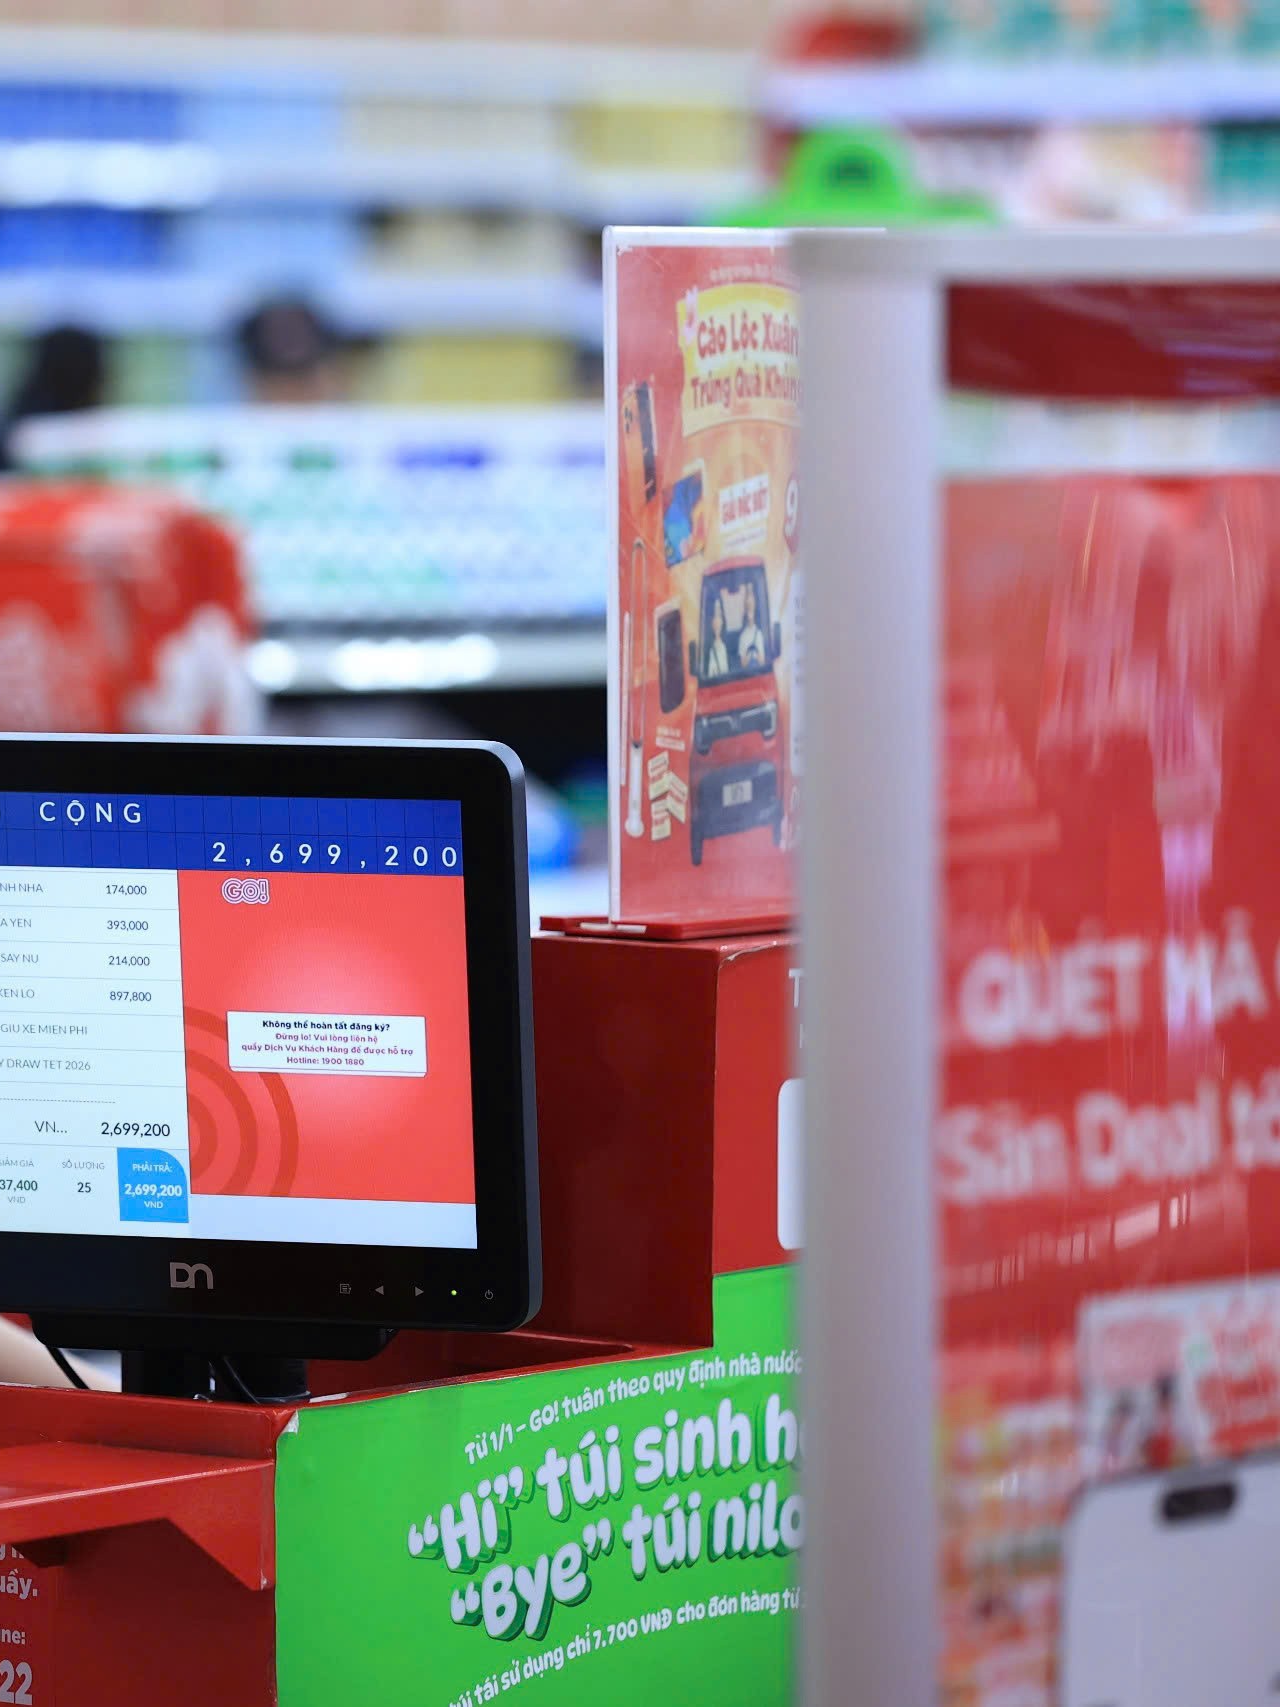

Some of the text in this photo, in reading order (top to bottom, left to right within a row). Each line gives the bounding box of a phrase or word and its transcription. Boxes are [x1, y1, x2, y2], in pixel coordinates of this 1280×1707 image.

[39, 800, 142, 825] CỘNG
[212, 842, 457, 868] 2,699,200
[18, 883, 44, 893] NHA
[105, 884, 147, 897] 174,000
[222, 878, 270, 905] GO!
[10, 918, 32, 928] YEN
[107, 920, 149, 933] 393,000
[1, 953, 20, 963] SAY
[22, 954, 39, 963] NU
[108, 955, 150, 968] 214,000
[21, 988, 35, 999] LO
[109, 991, 152, 1004] 897,800
[0, 1023, 20, 1033] GIU
[22, 1024, 36, 1034] XE
[38, 1024, 67, 1035] MIEN
[69, 1025, 88, 1035] PHI
[262, 1020, 292, 1031] Không
[6, 1058, 40, 1069] DRAW
[43, 1060, 62, 1070] TET
[65, 1061, 91, 1071] 2026
[286, 1056, 320, 1065] Hotline:
[322, 1057, 342, 1065] 1900
[101, 1122, 171, 1138] 2,699,200
[77, 1182, 92, 1193] 25
[124, 1184, 183, 1198] 2,699,200
[144, 1201, 164, 1209] VND
[464, 1431, 489, 1465] Từ
[490, 1422, 514, 1453] 1/1
[529, 1400, 560, 1433] GO!
[562, 1386, 605, 1420] tuân
[607, 1376, 650, 1403] theo
[653, 1367, 686, 1395] quy
[688, 1356, 726, 1389] định
[728, 1351, 761, 1377] nhà
[535, 1424, 623, 1518] túi
[633, 1397, 752, 1485] sinh
[622, 1490, 702, 1575] túi
[474, 1673, 499, 1706] tái
[500, 1659, 521, 1691] sử
[523, 1645, 565, 1679] dụng
[566, 1624, 592, 1659] chỉ
[593, 1618, 638, 1650] 7.700
[640, 1607, 673, 1635] VNĐ
[676, 1600, 706, 1625] cho
[740, 1589, 780, 1616] hàng
